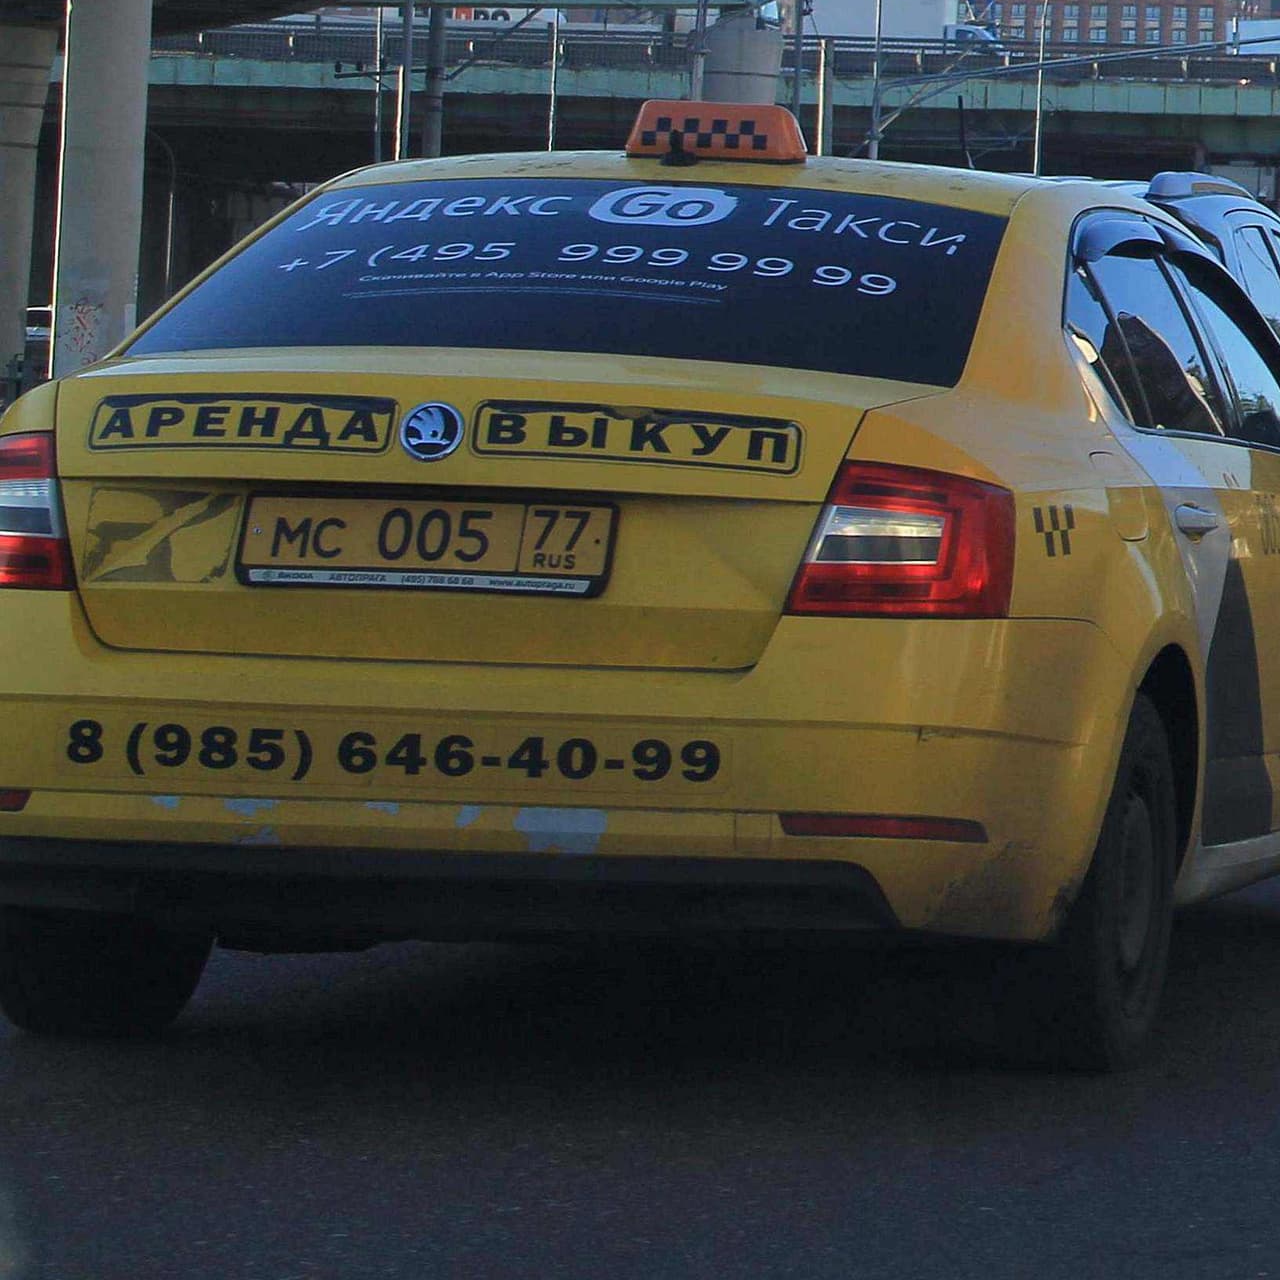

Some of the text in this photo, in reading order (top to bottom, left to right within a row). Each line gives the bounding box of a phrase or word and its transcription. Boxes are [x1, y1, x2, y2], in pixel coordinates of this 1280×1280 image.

[296, 191, 966, 255] Яндекс Go Такси
[279, 249, 356, 272] +7
[558, 243, 690, 267] 999
[707, 252, 794, 277] 99
[812, 265, 897, 296] 99
[359, 272, 467, 283] Скачивайте
[485, 270, 525, 280] App
[528, 271, 577, 279] Store
[619, 275, 686, 287] Google
[689, 280, 729, 291] Play
[100, 406, 378, 447] АРЕНДА
[487, 414, 789, 463] ВЫКУП
[378, 507, 493, 562] 005
[533, 510, 591, 551] 77
[532, 553, 576, 570] RUS
[66, 720, 721, 782] 8 (985) 646-40-99
